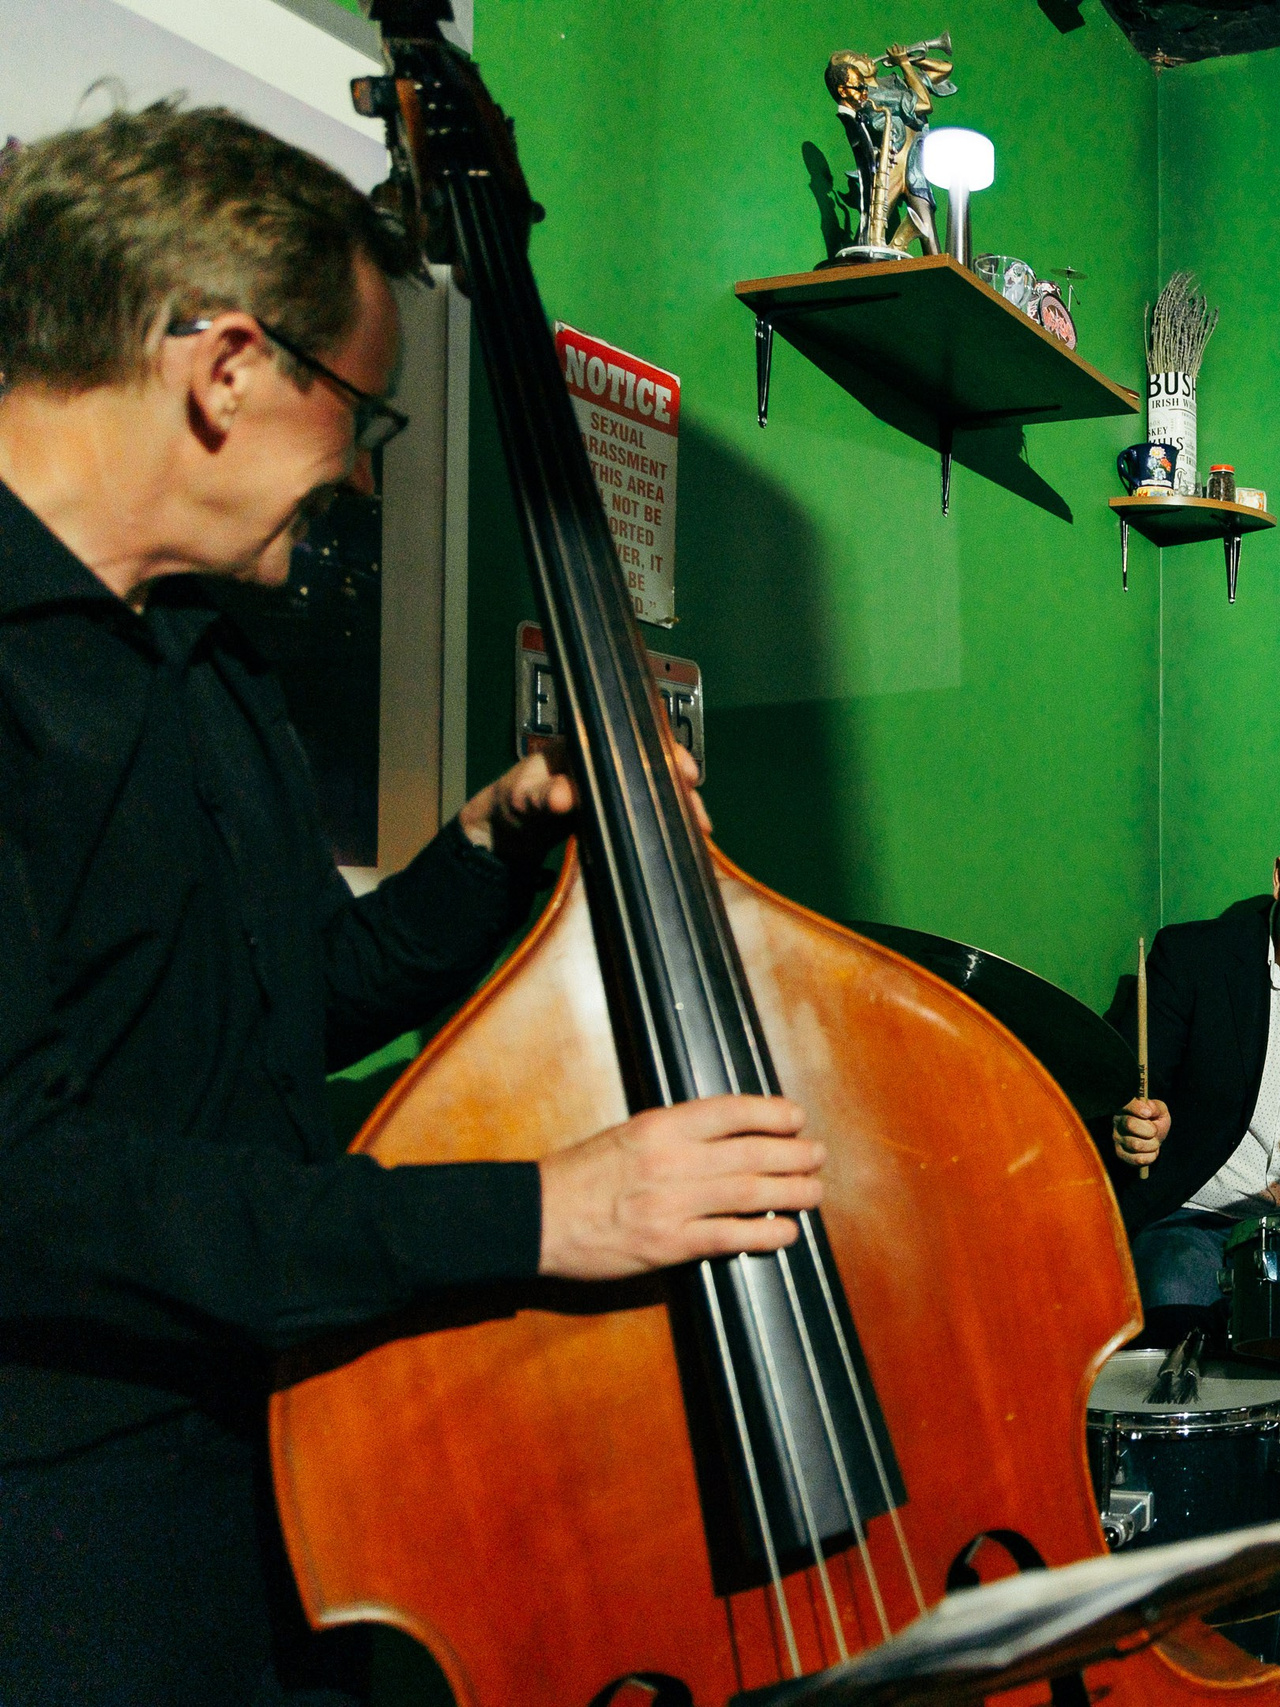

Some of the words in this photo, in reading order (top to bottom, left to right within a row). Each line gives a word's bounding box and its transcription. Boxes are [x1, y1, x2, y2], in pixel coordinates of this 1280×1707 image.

[565, 344, 672, 424] NOTICE
[1152, 398, 1179, 409] IRISH
[591, 411, 646, 450] SEXUAL
[581, 432, 668, 481] ARASSMENT
[590, 461, 622, 488] THIS
[627, 474, 665, 505] AREA
[612, 493, 639, 518] NOT
[644, 504, 662, 527] BE
[608, 516, 655, 547] ORTED
[650, 554, 664, 574] IT
[628, 571, 646, 592] BE
